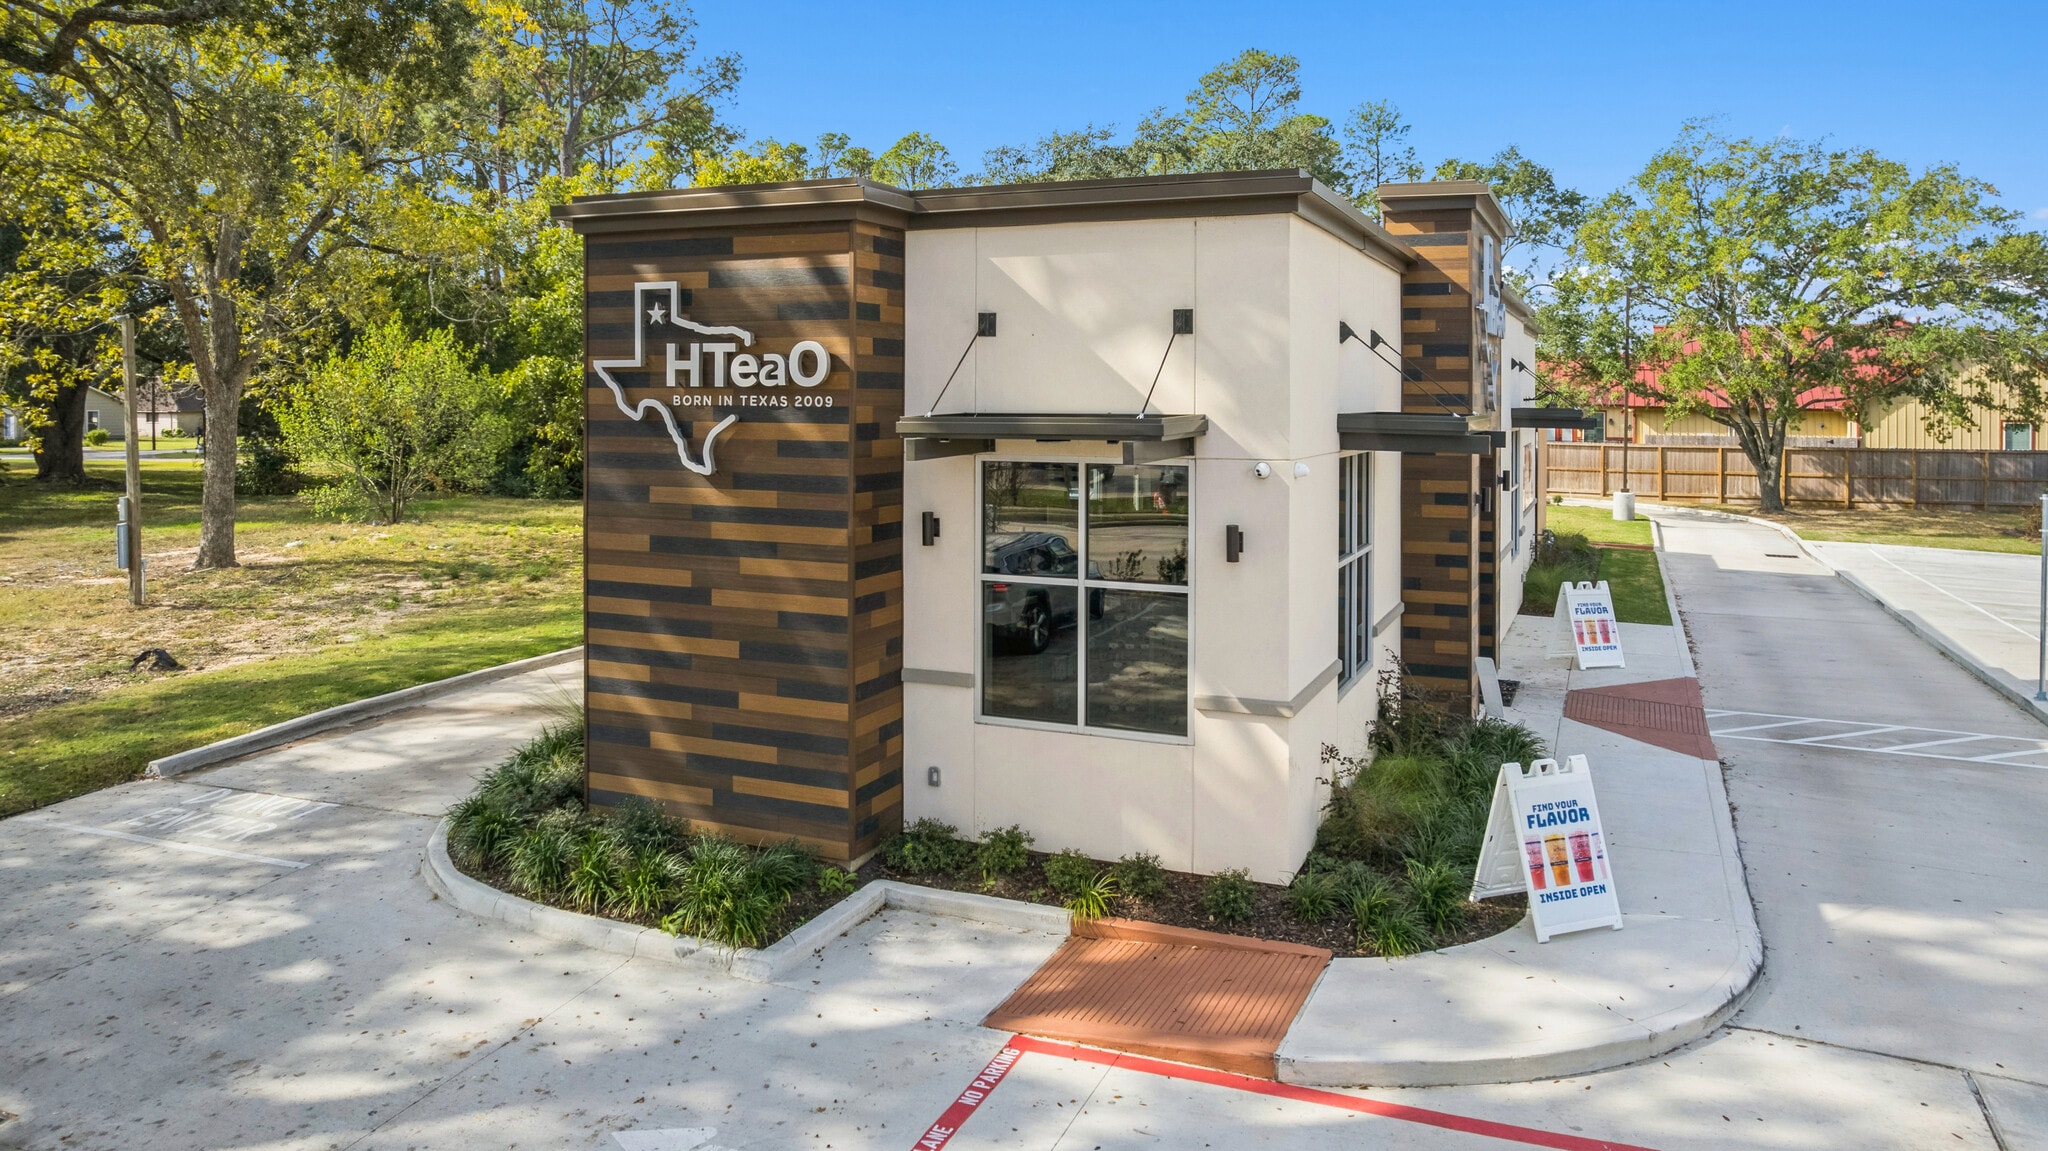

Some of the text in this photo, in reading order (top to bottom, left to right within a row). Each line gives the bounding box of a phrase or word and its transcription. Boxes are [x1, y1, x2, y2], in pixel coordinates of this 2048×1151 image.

[665, 340, 831, 388] HTeaO
[672, 395, 834, 408] BORN IN TEXAS 2009
[1575, 607, 1609, 615] FLAVOR
[1532, 799, 1578, 812] FIND YOUR
[1526, 807, 1590, 829] FLAVOR
[1540, 884, 1607, 903] INSIDE OPEN
[910, 1048, 1020, 1151] ANE NO PARKING
